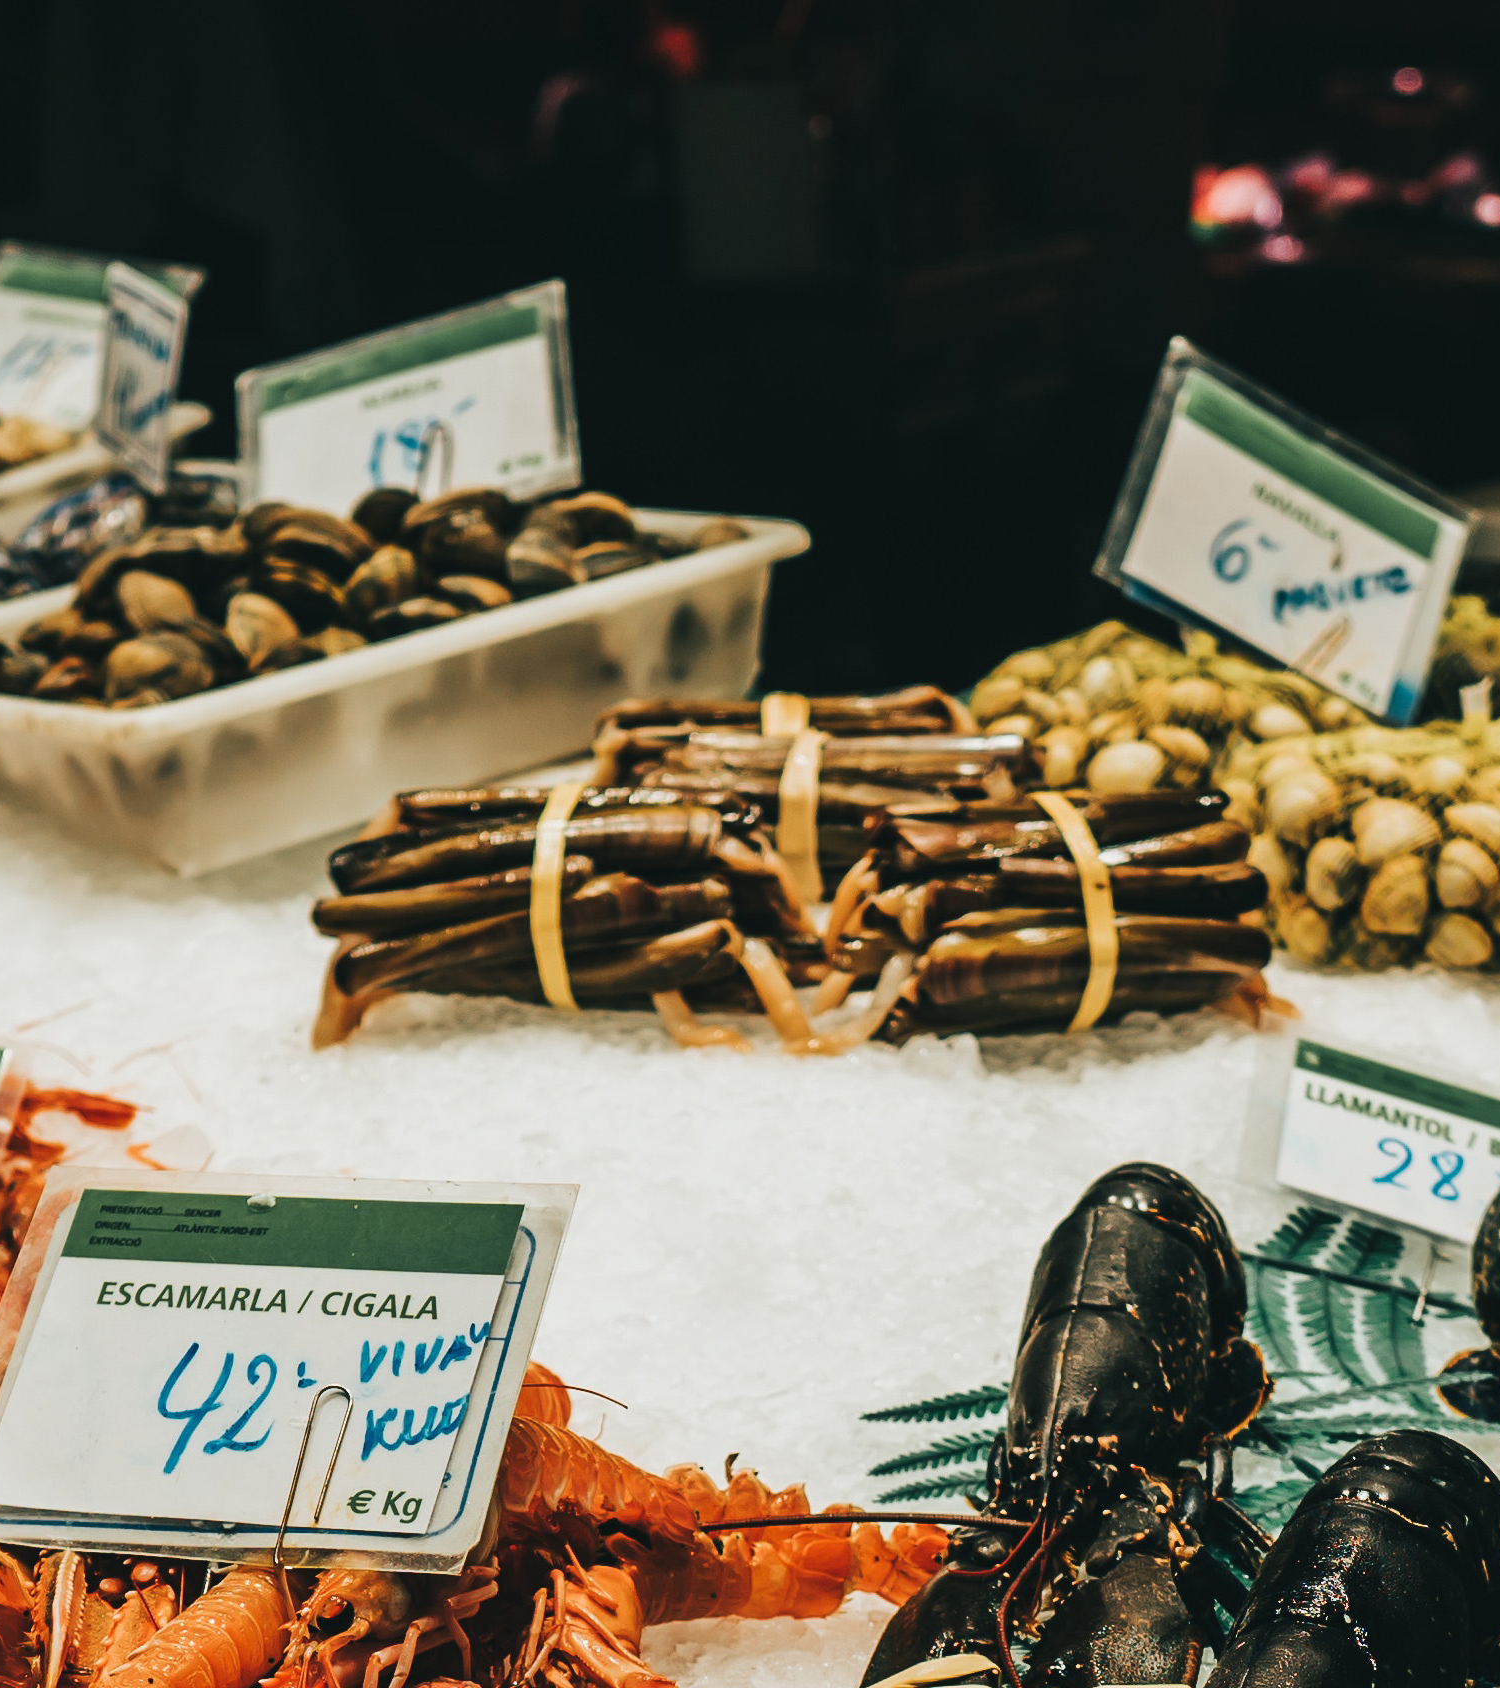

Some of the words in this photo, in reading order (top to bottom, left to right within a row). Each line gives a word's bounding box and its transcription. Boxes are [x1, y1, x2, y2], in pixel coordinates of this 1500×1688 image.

[1305, 1082, 1456, 1145] LLAMANTOL
[1371, 1137, 1466, 1202] 28
[96, 1281, 288, 1313] ESCAMARLA
[298, 1290, 314, 1314] /
[320, 1291, 439, 1320] CIGALA
[347, 1490, 376, 1515] €
[383, 1490, 423, 1524] Kg
